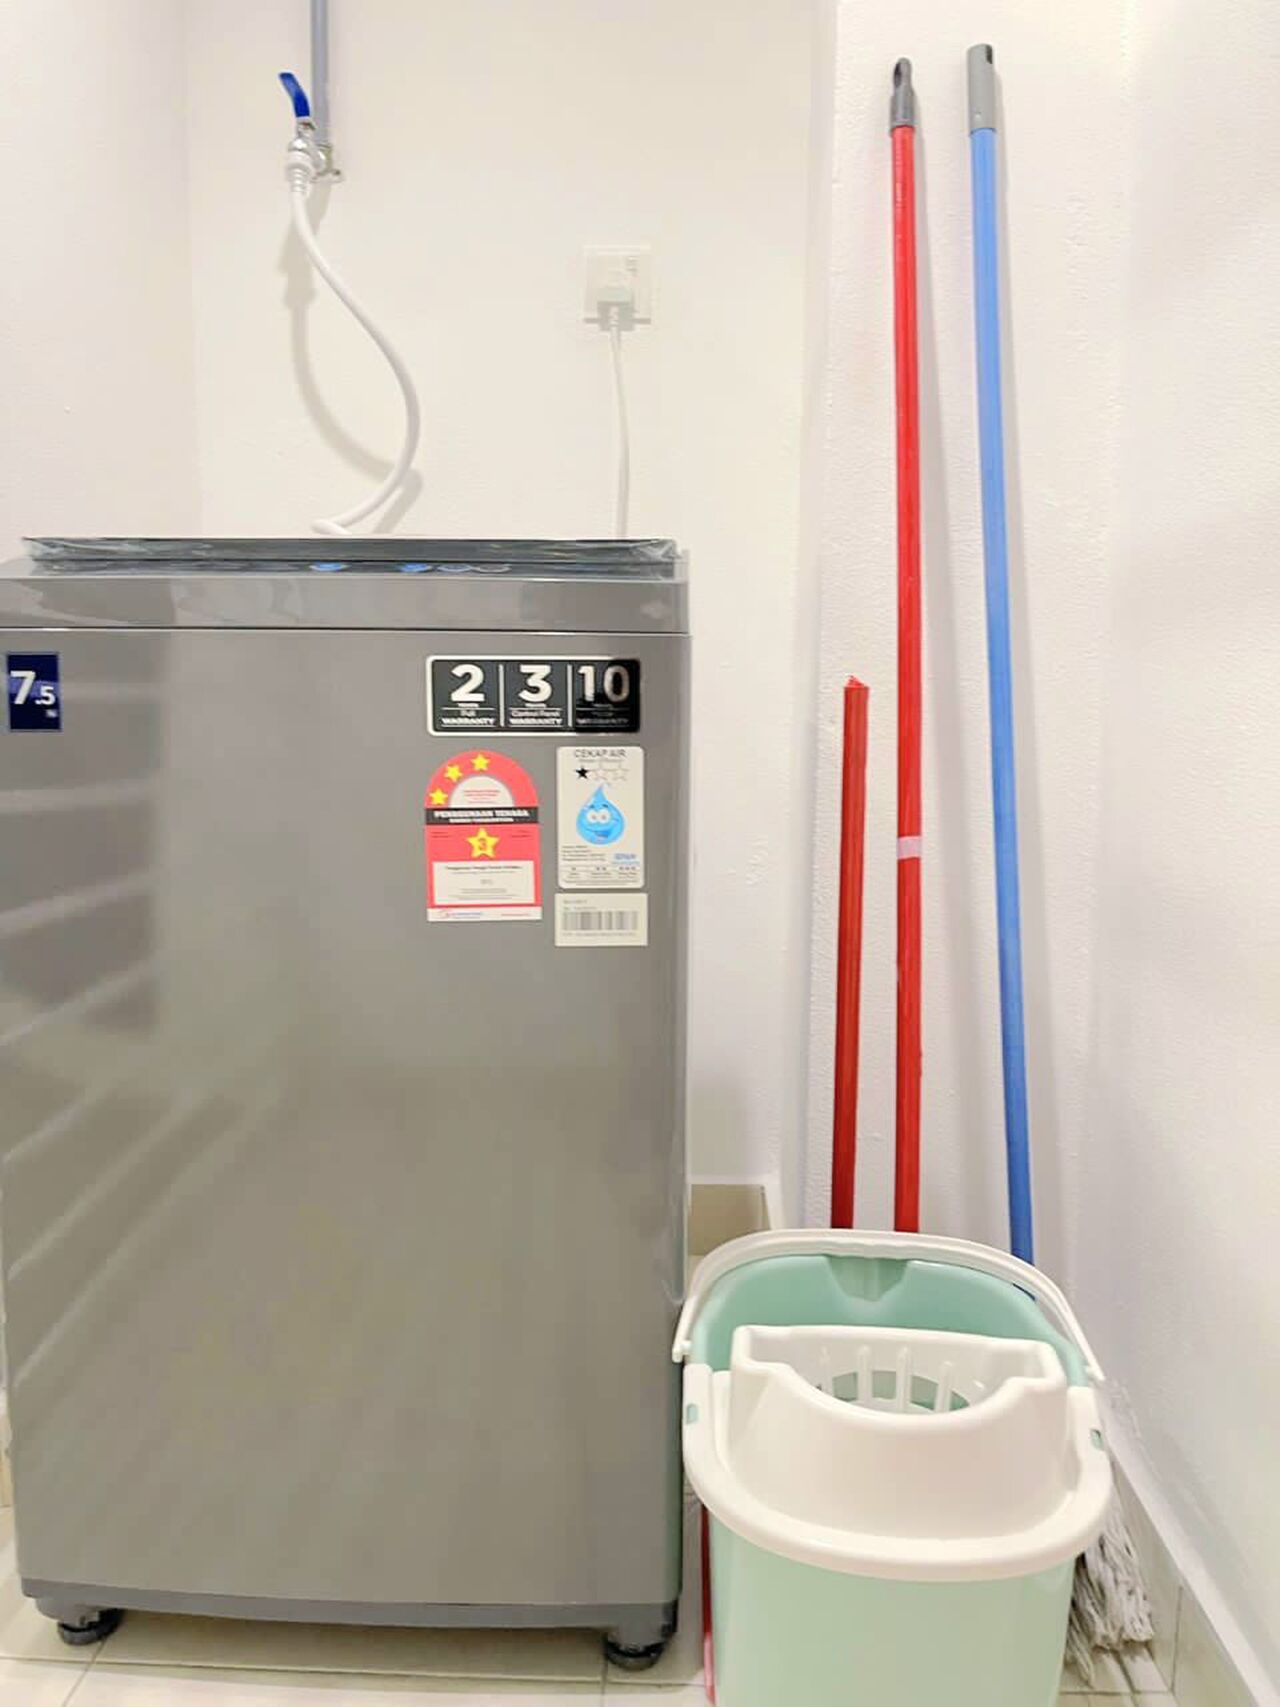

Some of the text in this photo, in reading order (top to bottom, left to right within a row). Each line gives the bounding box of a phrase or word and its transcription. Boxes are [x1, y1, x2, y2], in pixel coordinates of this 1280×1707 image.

[450, 663, 485, 702] 2
[518, 664, 553, 703] 3
[577, 665, 630, 703] 10
[478, 838, 488, 852] 3
